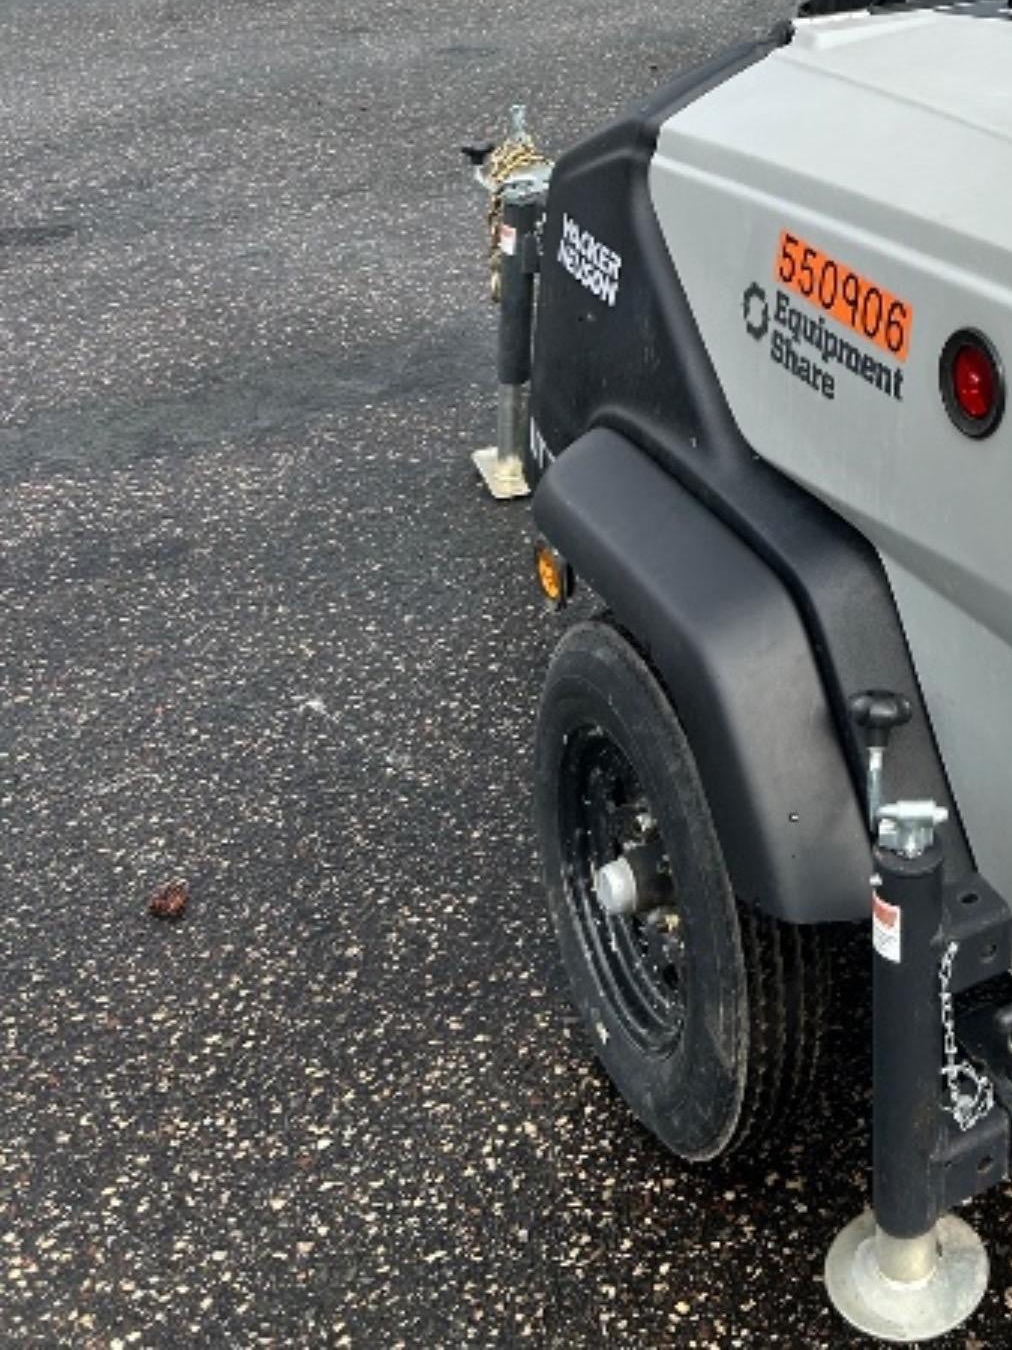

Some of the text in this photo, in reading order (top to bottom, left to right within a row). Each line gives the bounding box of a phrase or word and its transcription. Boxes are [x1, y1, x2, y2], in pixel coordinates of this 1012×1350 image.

[557, 239, 619, 307] NEUSON
[562, 212, 622, 275] WACKER
[778, 233, 907, 354] 550906
[770, 329, 835, 400] Share
[774, 289, 904, 401] Equipment
